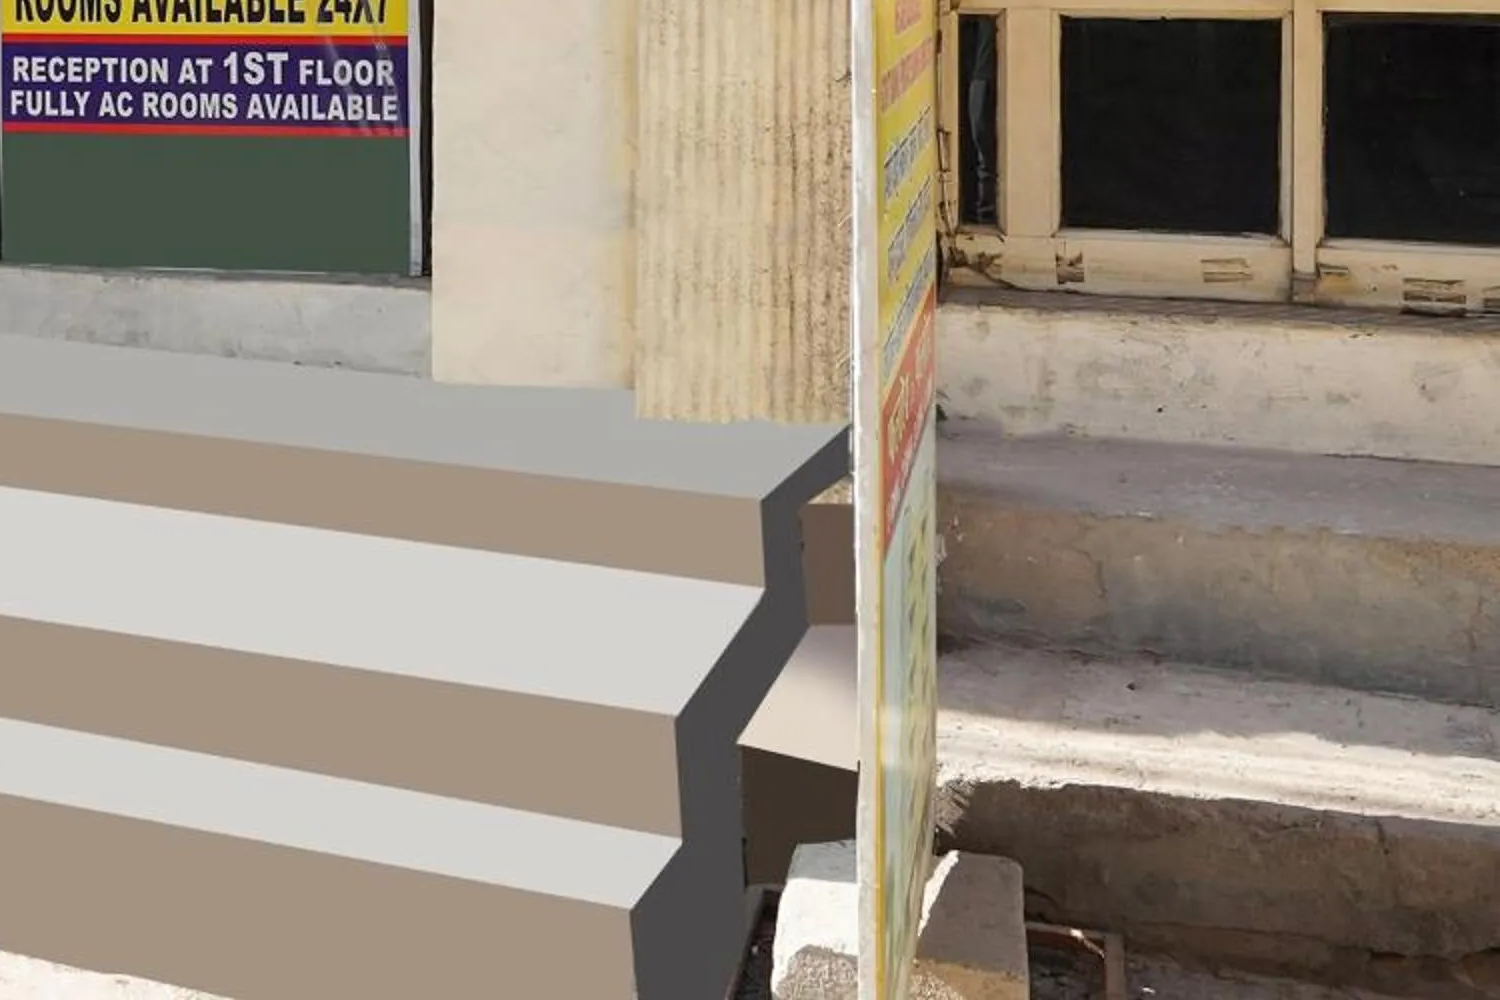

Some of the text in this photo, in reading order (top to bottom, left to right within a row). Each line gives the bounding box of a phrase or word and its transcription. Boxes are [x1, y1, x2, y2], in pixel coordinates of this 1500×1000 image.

[12, 51, 395, 87] RECEPTION AT 1ST FLOOR
[11, 90, 398, 121] FULLY AC ROOMS AVAILABLE
